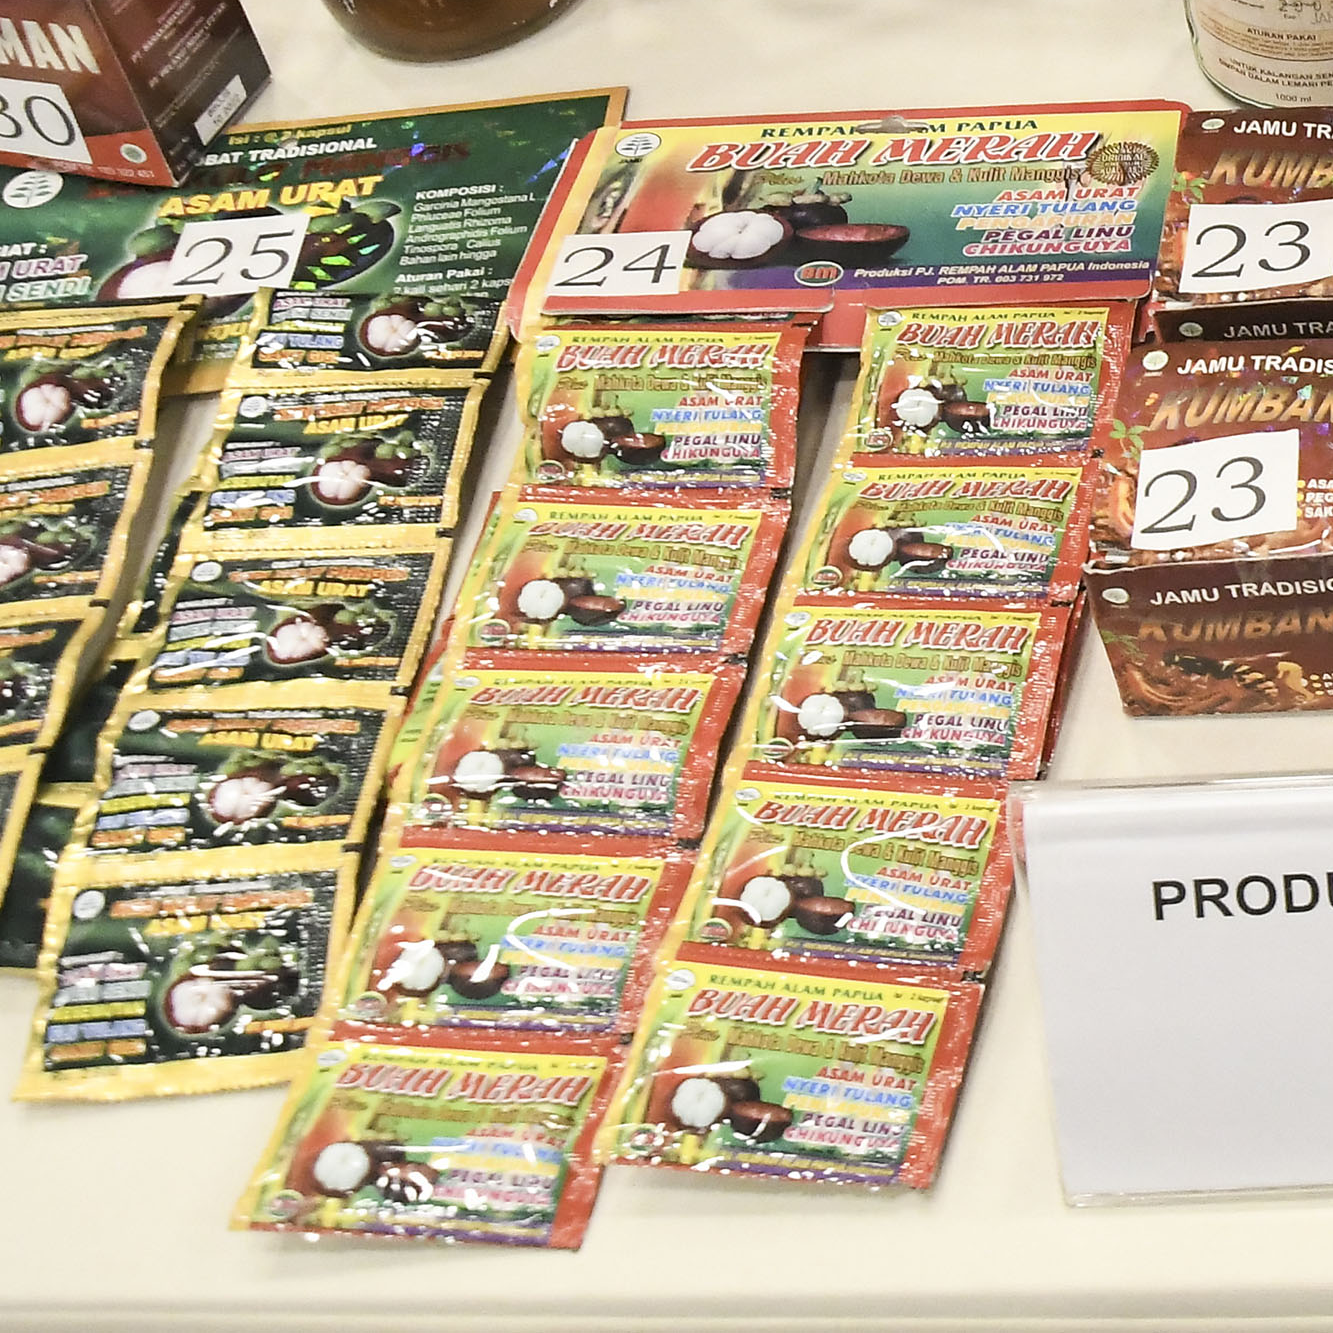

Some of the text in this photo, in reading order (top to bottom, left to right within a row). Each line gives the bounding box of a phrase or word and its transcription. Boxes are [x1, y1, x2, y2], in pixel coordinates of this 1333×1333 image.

[957, 119, 1038, 132] PAPUA
[1234, 118, 1297, 137] JAMU
[249, 138, 378, 161] TRADISIONAL
[691, 131, 1101, 172] BUAH MERAH
[821, 170, 895, 187] Mahkota
[900, 169, 945, 184] Dewa
[950, 169, 962, 182] &
[967, 167, 1006, 182] Kulit
[160, 175, 384, 218] ASAM URAT
[416, 184, 496, 200] KOMPOSISI
[951, 199, 1136, 218] NYERI TULANG
[985, 225, 1134, 243] PEGAL LINU
[173, 228, 295, 287] 25
[962, 239, 1132, 257] CHIKUNGUYA
[1192, 220, 1311, 278] 23
[554, 243, 678, 287] 24
[854, 268, 912, 278] Produksi
[939, 265, 996, 276] REMPAH
[1000, 263, 1037, 275] ALAM
[1039, 262, 1085, 273] PAPUA
[1177, 356, 1244, 375] JAMU
[1139, 457, 1266, 534] 23
[1150, 586, 1220, 607] JAMU
[804, 618, 1031, 654] BUAH MERAH
[686, 988, 939, 1047] BUAH MERAH
